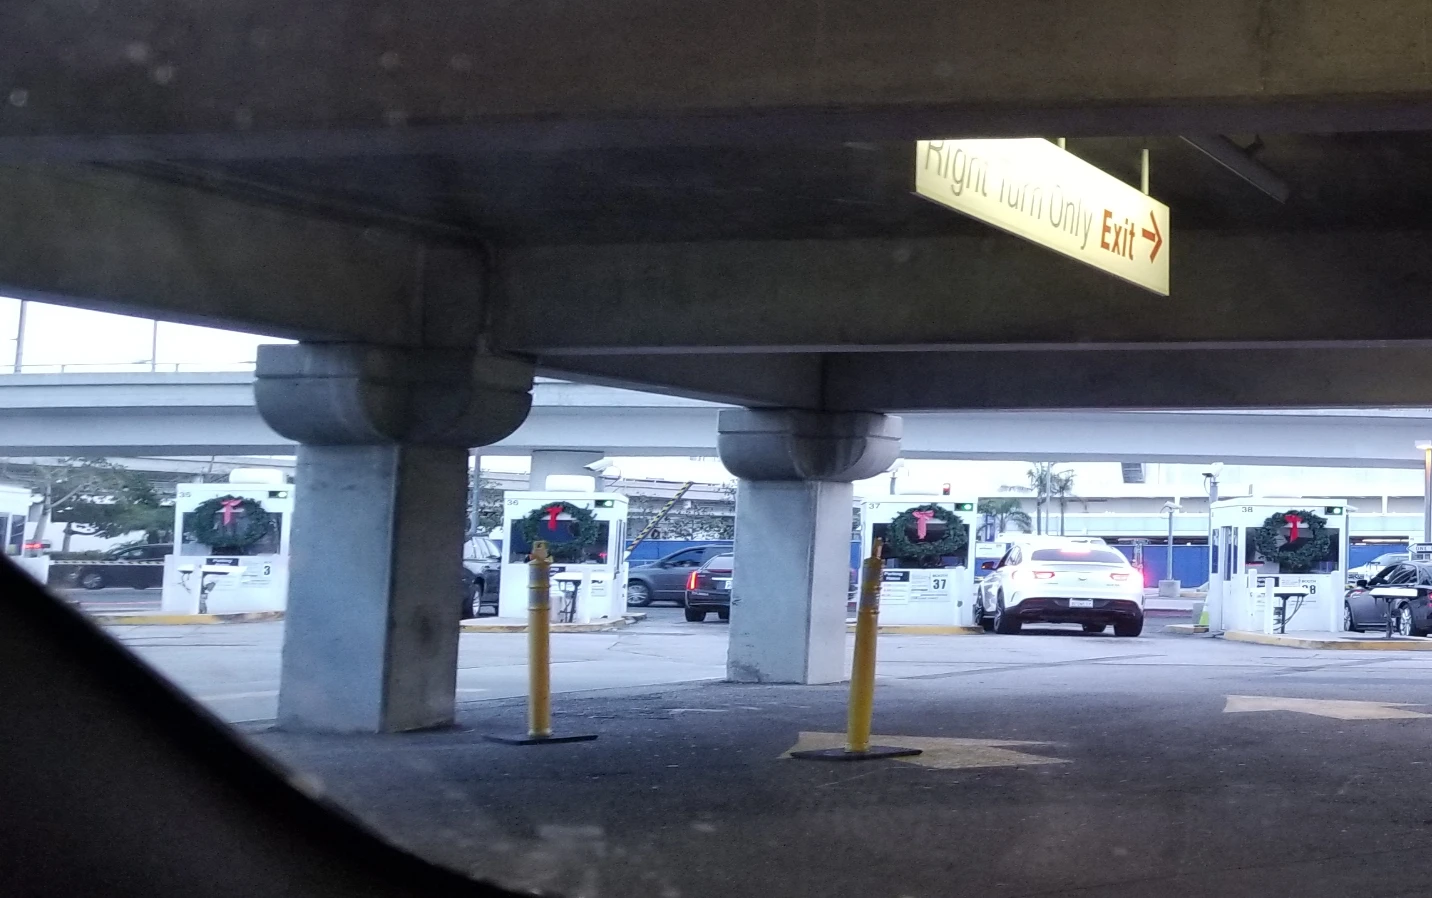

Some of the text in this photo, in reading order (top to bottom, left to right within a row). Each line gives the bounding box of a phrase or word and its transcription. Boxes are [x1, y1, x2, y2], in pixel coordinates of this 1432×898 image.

[1050, 184, 1093, 250] Only
[1100, 208, 1136, 261] Exit
[932, 579, 947, 590] 37
